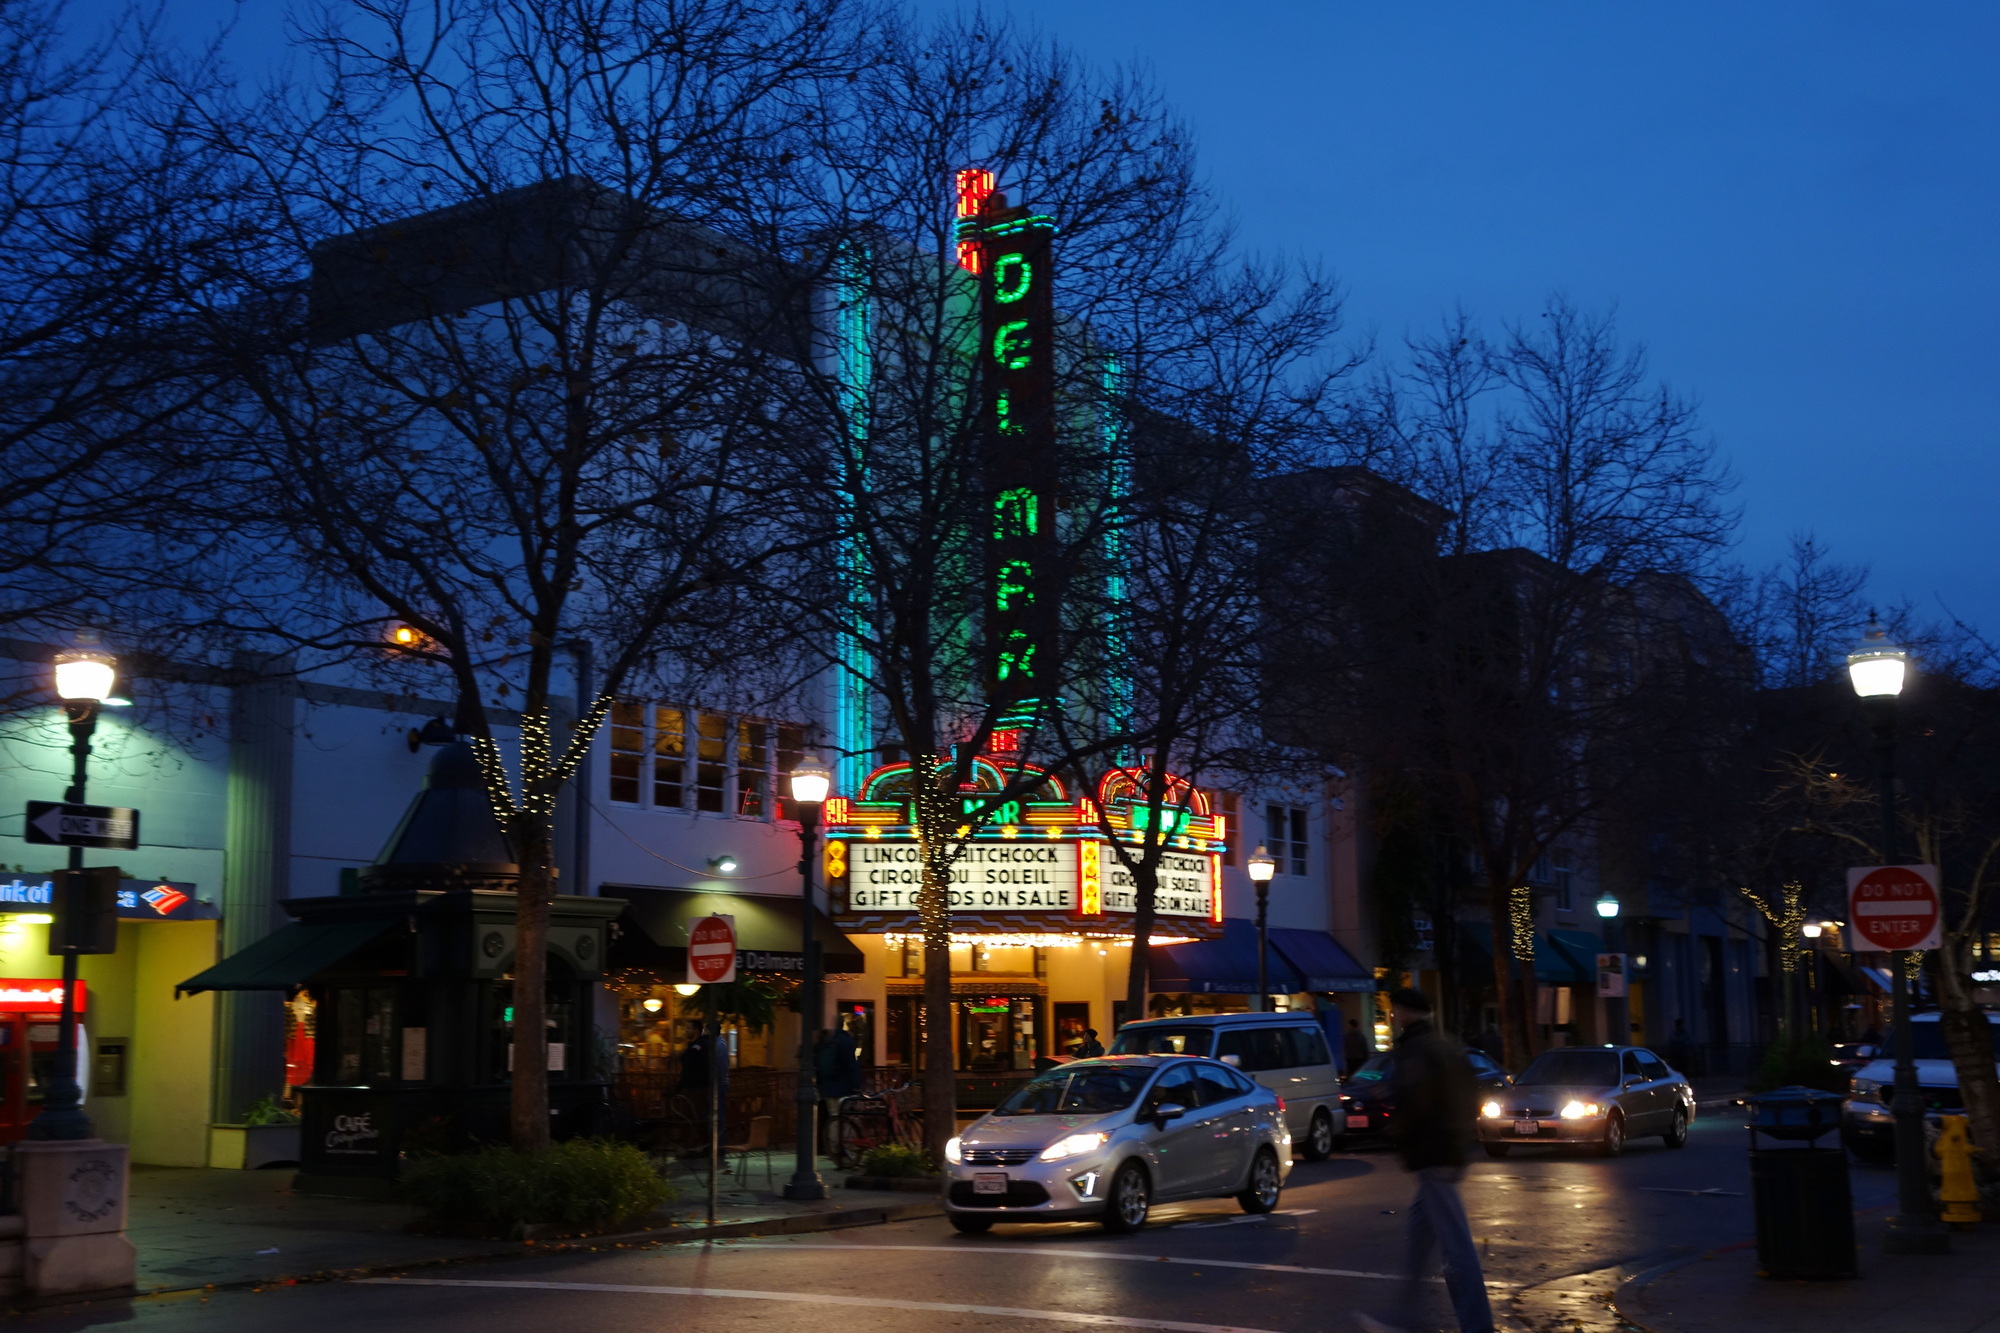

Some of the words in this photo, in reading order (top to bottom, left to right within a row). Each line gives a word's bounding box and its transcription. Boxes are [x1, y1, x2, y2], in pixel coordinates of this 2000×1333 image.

[986, 869, 1049, 885] SOLEIL
[1862, 884, 1885, 897] DO
[1890, 883, 1924, 897] NOT
[855, 890, 901, 906] GIFT
[908, 890, 974, 906] CDS
[983, 890, 1009, 906] ON
[1017, 890, 1069, 906] SALE
[1869, 920, 1920, 934] ENTER
[695, 930, 708, 941] DO
[697, 958, 726, 970] ENTER
